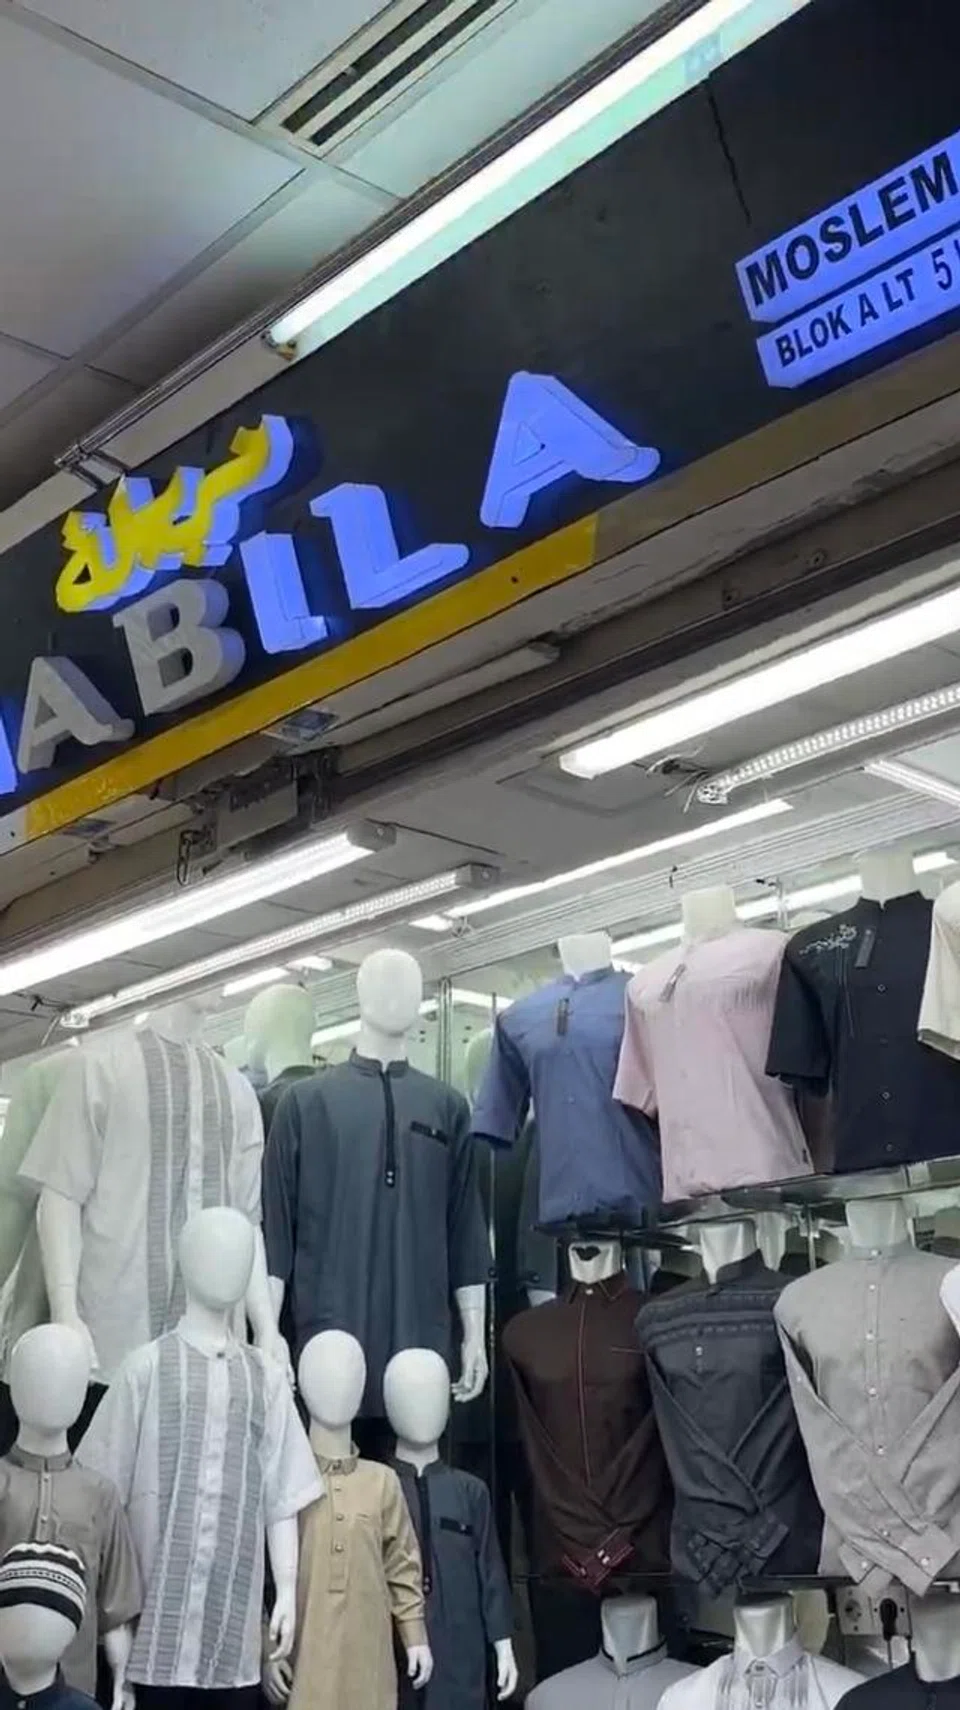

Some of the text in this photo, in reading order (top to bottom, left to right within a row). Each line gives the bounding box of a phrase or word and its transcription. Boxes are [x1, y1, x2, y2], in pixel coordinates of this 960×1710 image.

[745, 151, 958, 307] MOSLEM
[775, 304, 852, 367] BLOK
[859, 293, 880, 326] A
[881, 269, 914, 312] LT
[0, 371, 660, 793] ABILA
